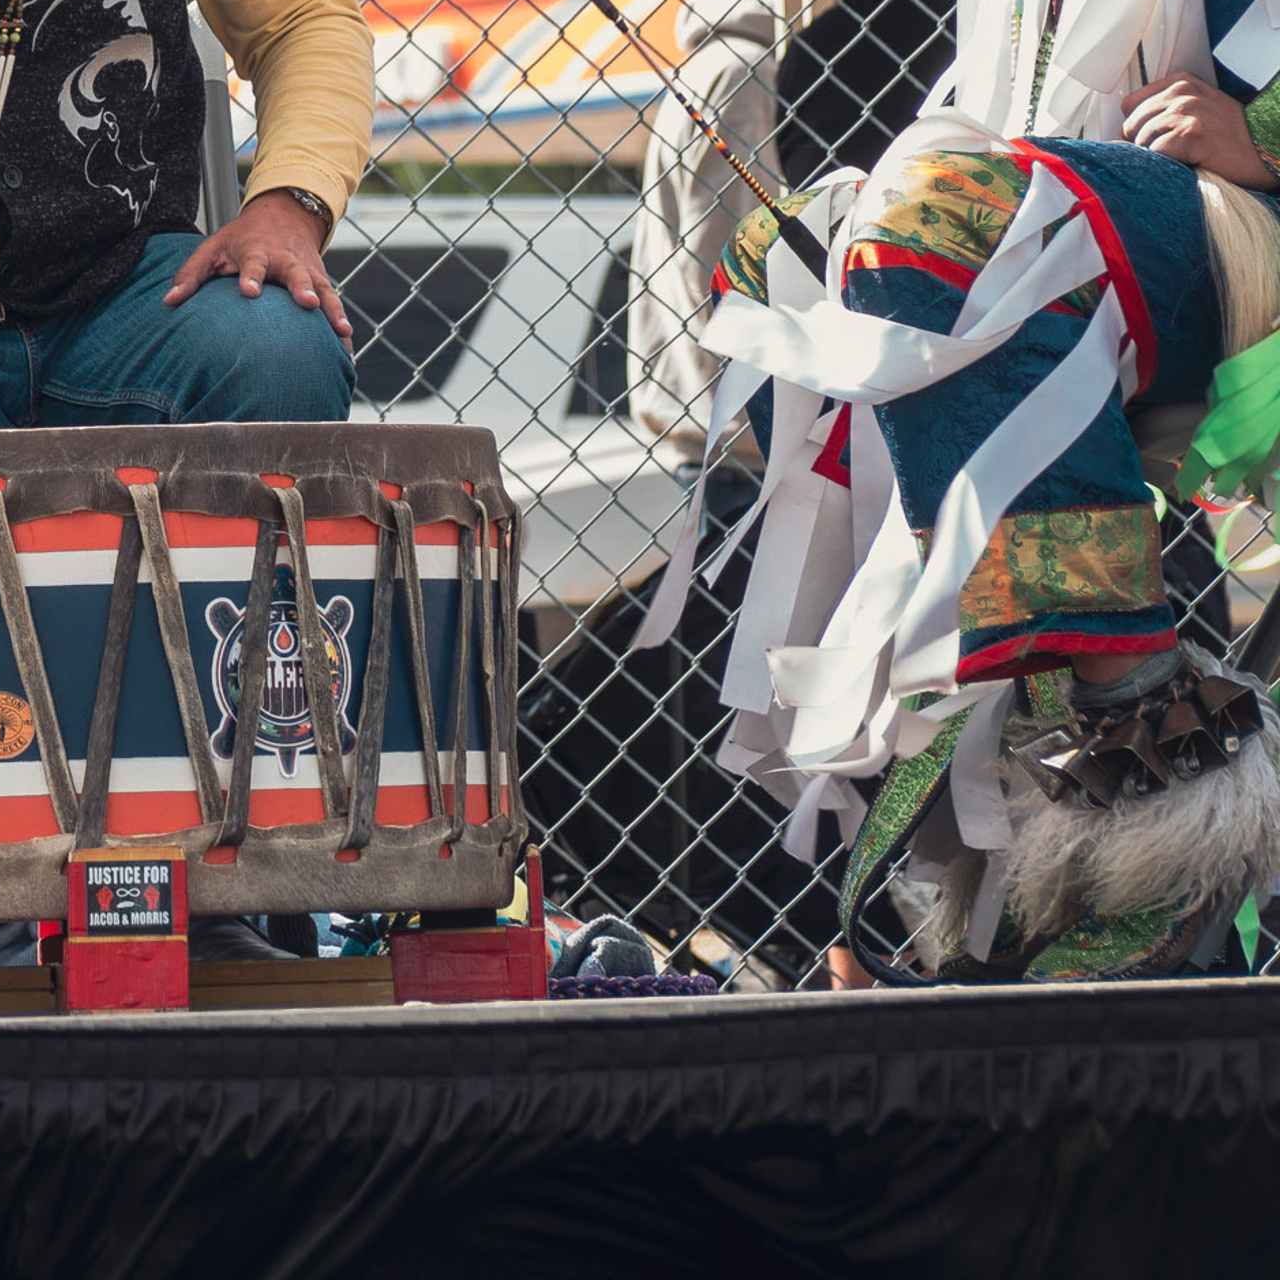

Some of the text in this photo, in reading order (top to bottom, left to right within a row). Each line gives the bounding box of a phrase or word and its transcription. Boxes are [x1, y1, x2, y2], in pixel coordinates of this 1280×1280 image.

[88, 866, 169, 885] JUSTICE FOR
[89, 911, 170, 926] JACOB & MORRIS
